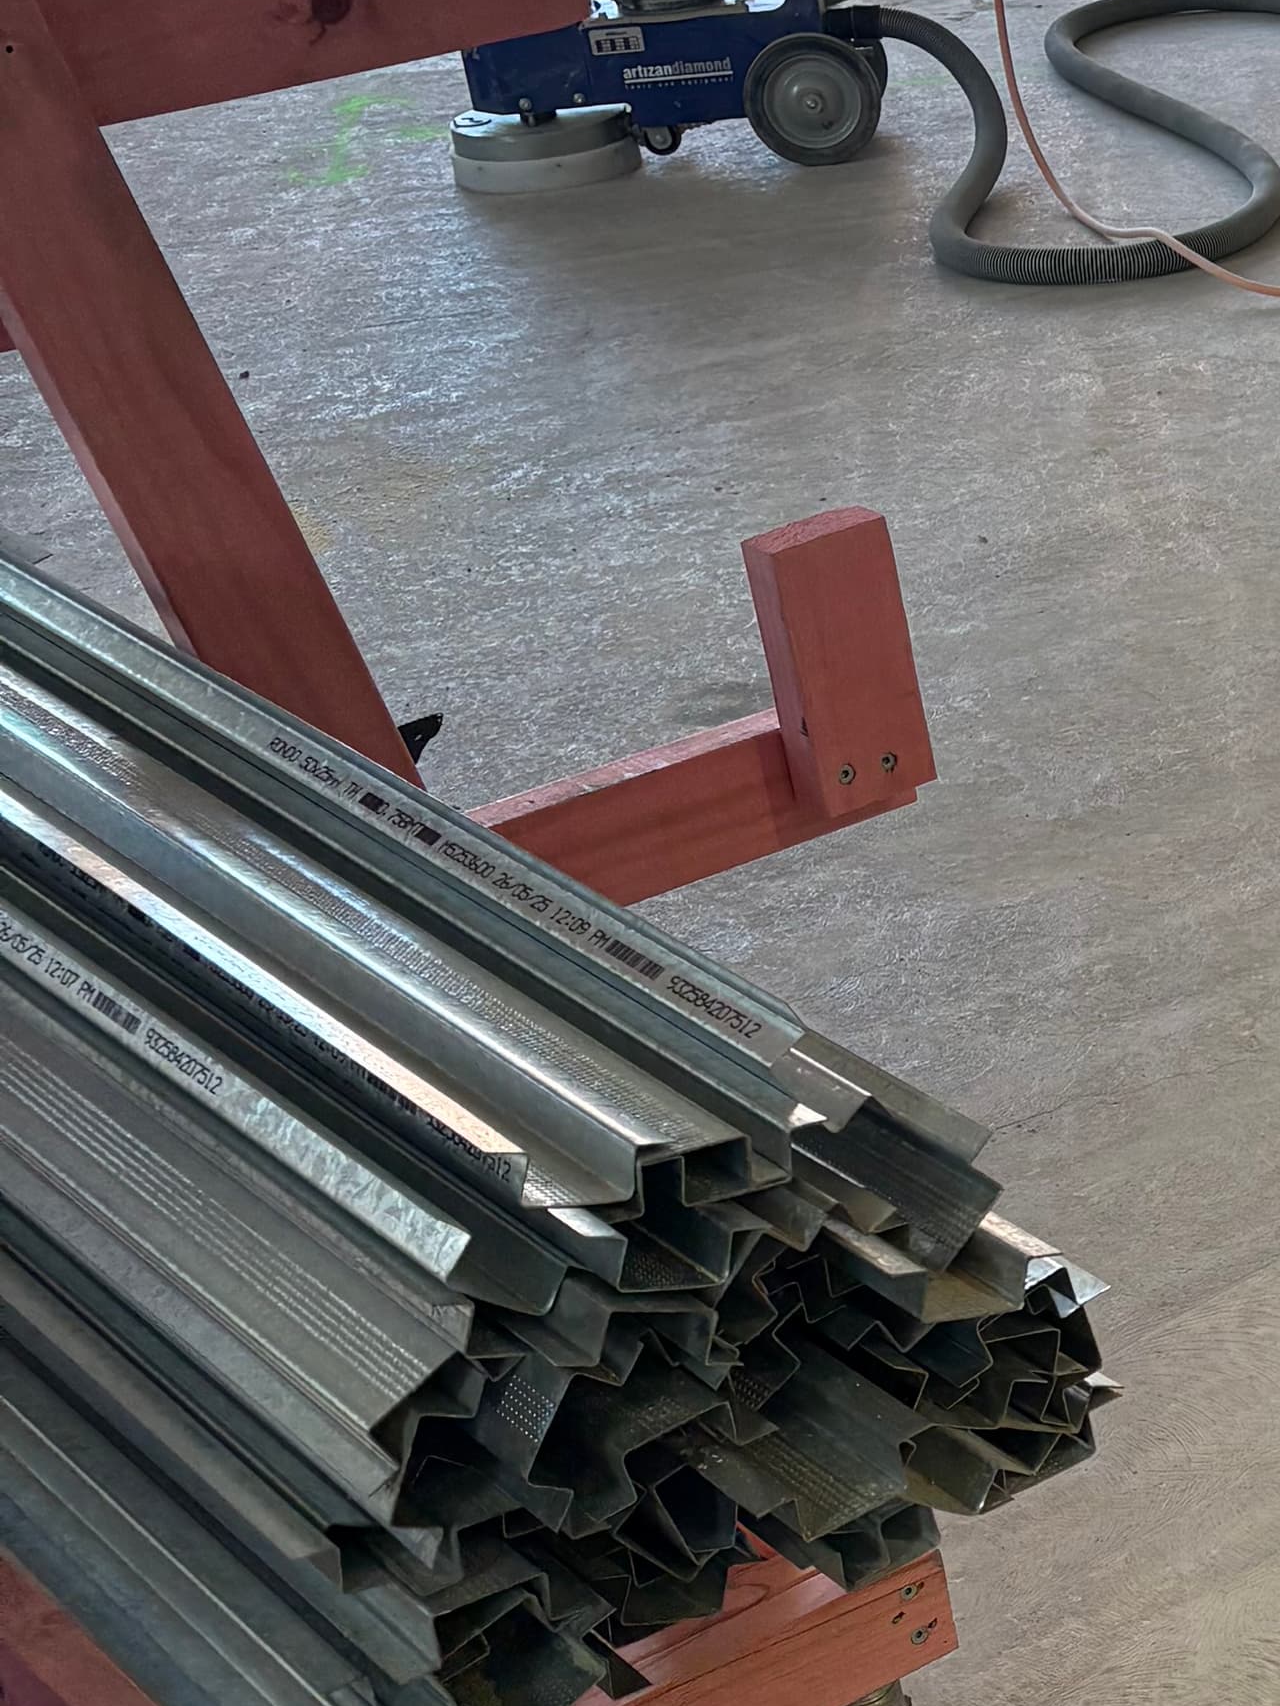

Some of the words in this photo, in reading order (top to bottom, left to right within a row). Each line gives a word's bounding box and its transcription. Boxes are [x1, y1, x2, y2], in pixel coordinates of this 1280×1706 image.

[491, 869, 552, 915] 26/05/25
[549, 904, 592, 939] 12:09
[587, 926, 613, 950] PM
[44, 957, 80, 989] 12:07
[76, 981, 97, 1004] PM
